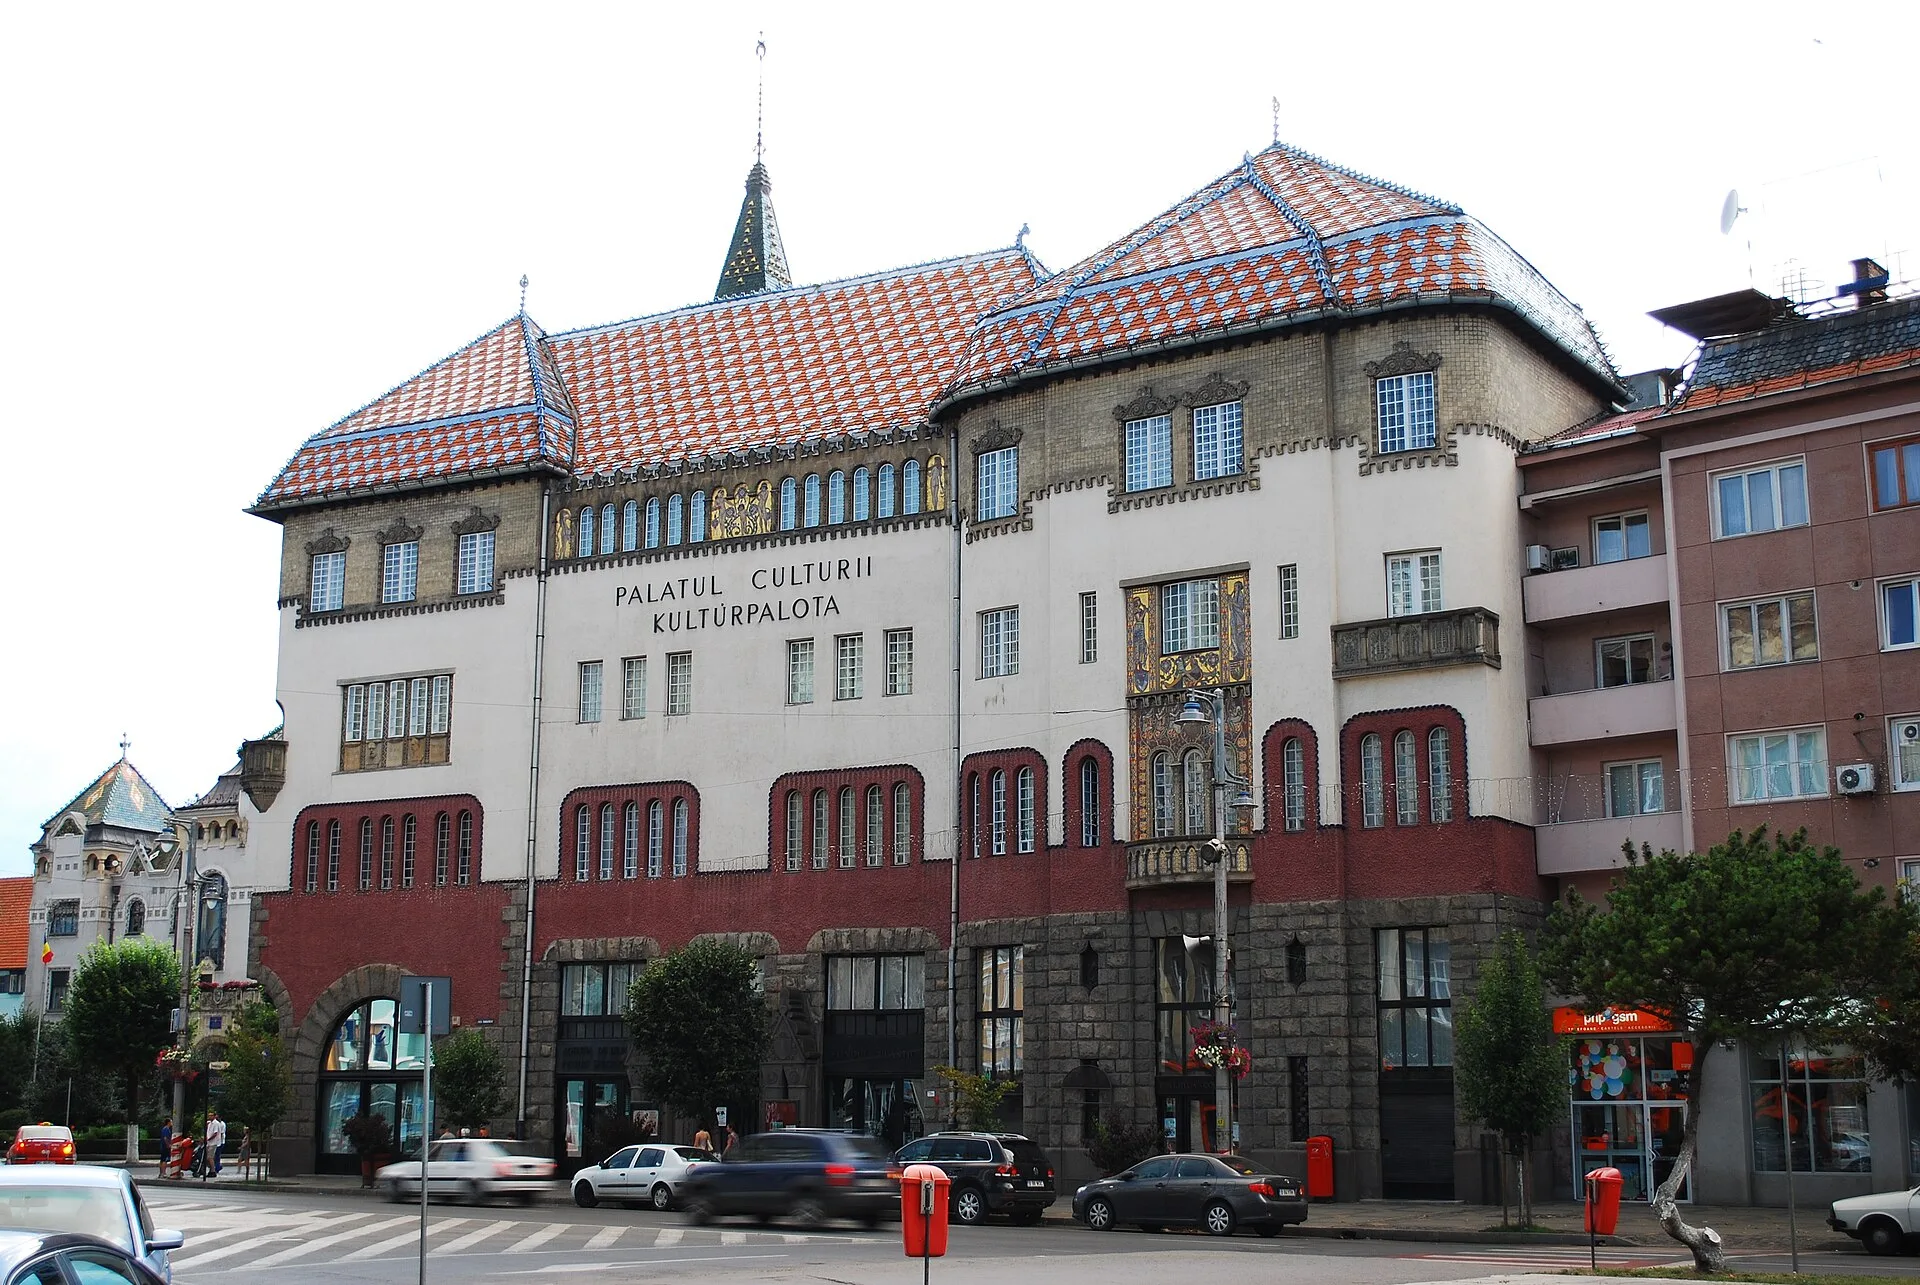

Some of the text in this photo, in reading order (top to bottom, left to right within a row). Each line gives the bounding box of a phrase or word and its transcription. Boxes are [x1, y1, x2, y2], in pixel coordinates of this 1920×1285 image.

[615, 556, 872, 607] PALATUL CULTURII
[653, 595, 840, 634] KULTÚRPALOTA
[1611, 1012, 1638, 1025] gsm
